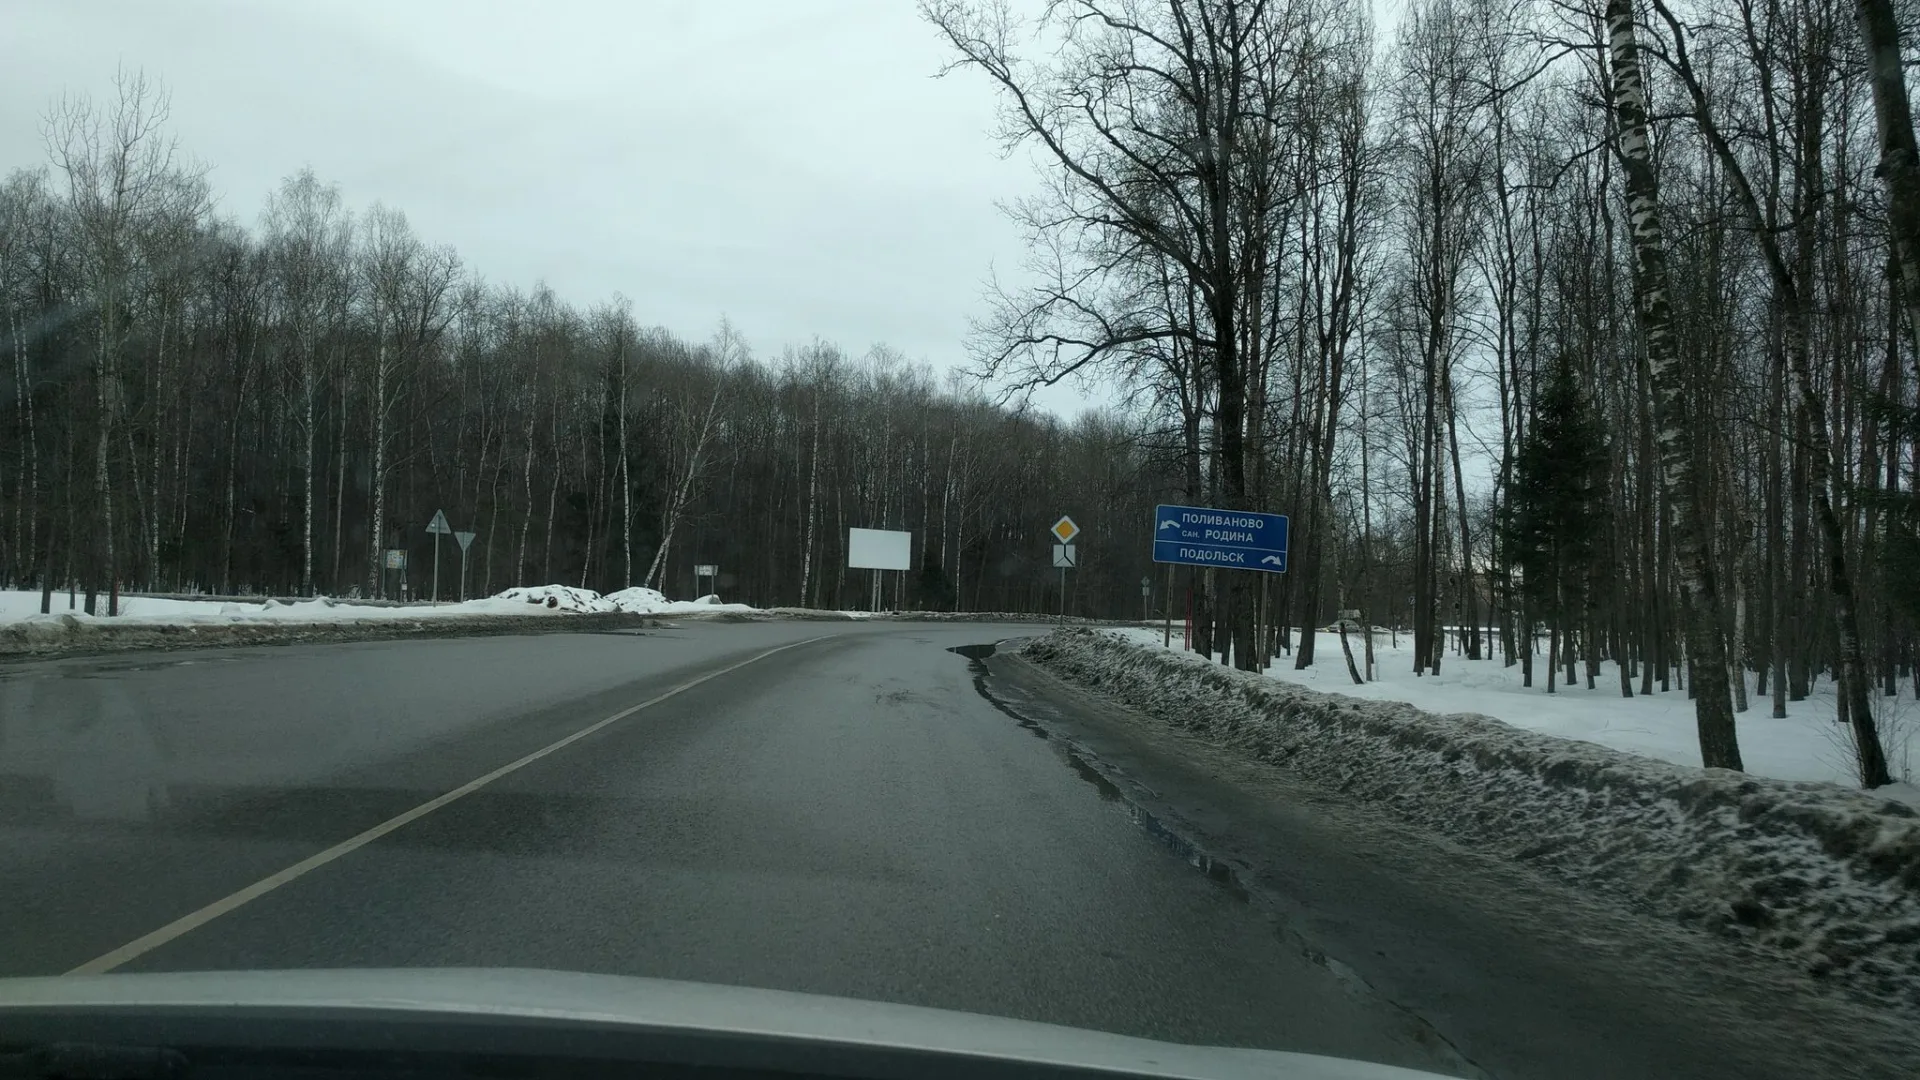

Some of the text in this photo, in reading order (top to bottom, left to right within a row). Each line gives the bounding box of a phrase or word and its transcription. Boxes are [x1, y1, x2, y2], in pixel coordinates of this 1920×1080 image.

[1182, 513, 1264, 529] ПОЛИВАНОВО
[1181, 529, 1254, 542] САН. РОДИНА
[1179, 548, 1245, 563] ПОДОЛЬСК
